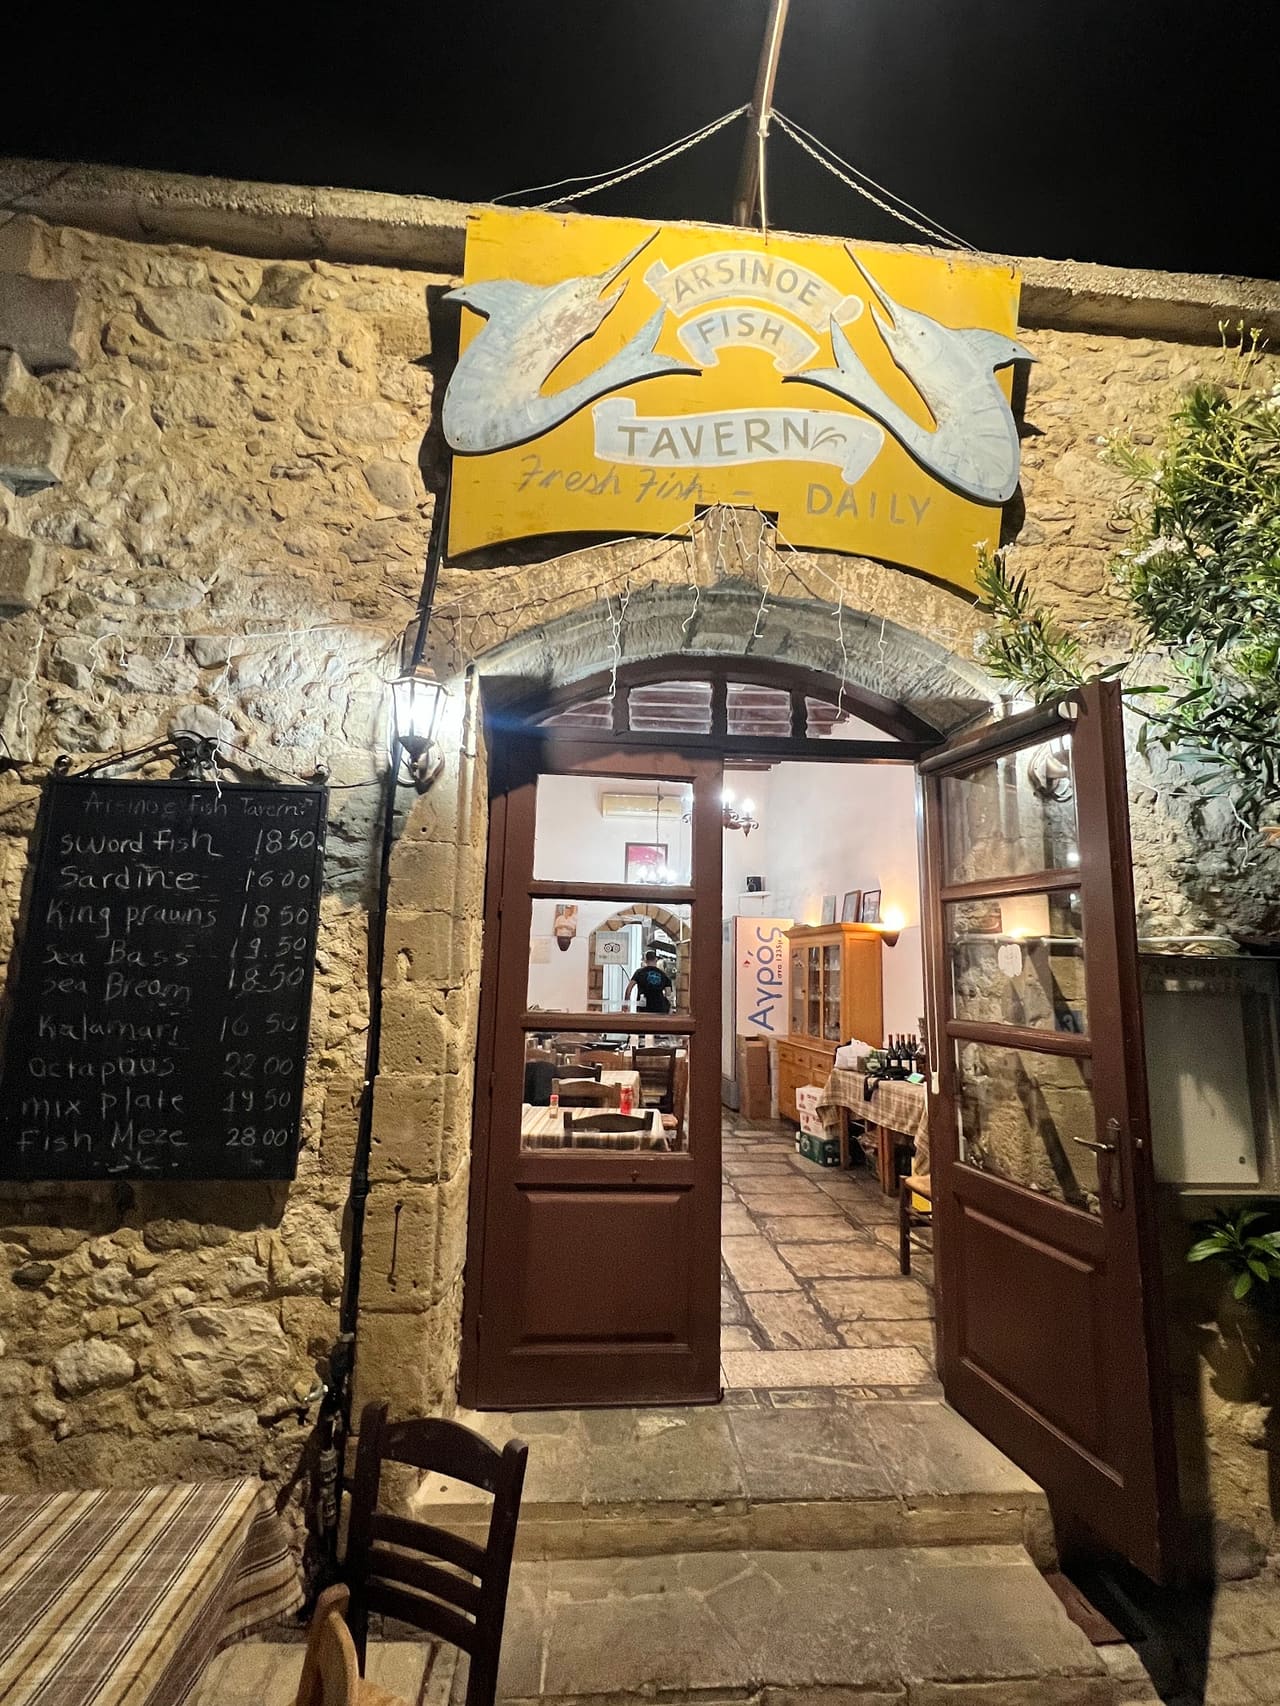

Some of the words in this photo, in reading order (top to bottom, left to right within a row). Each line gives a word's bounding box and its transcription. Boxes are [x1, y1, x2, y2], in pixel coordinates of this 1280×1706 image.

[673, 255, 820, 306] ARSINOE
[697, 311, 785, 346] FISH
[617, 416, 811, 460] TAVERN
[517, 453, 622, 496] Fresh
[634, 467, 706, 503] Fish
[806, 483, 932, 526] DAILY
[190, 793, 228, 817] Fish
[60, 866, 200, 891] Sardine
[46, 901, 110, 938] King
[126, 903, 217, 933] prawns
[104, 940, 189, 967] Bass
[102, 1086, 185, 1120] plate
[16, 1129, 92, 1153] Fish
[111, 1120, 189, 1151] Meze
